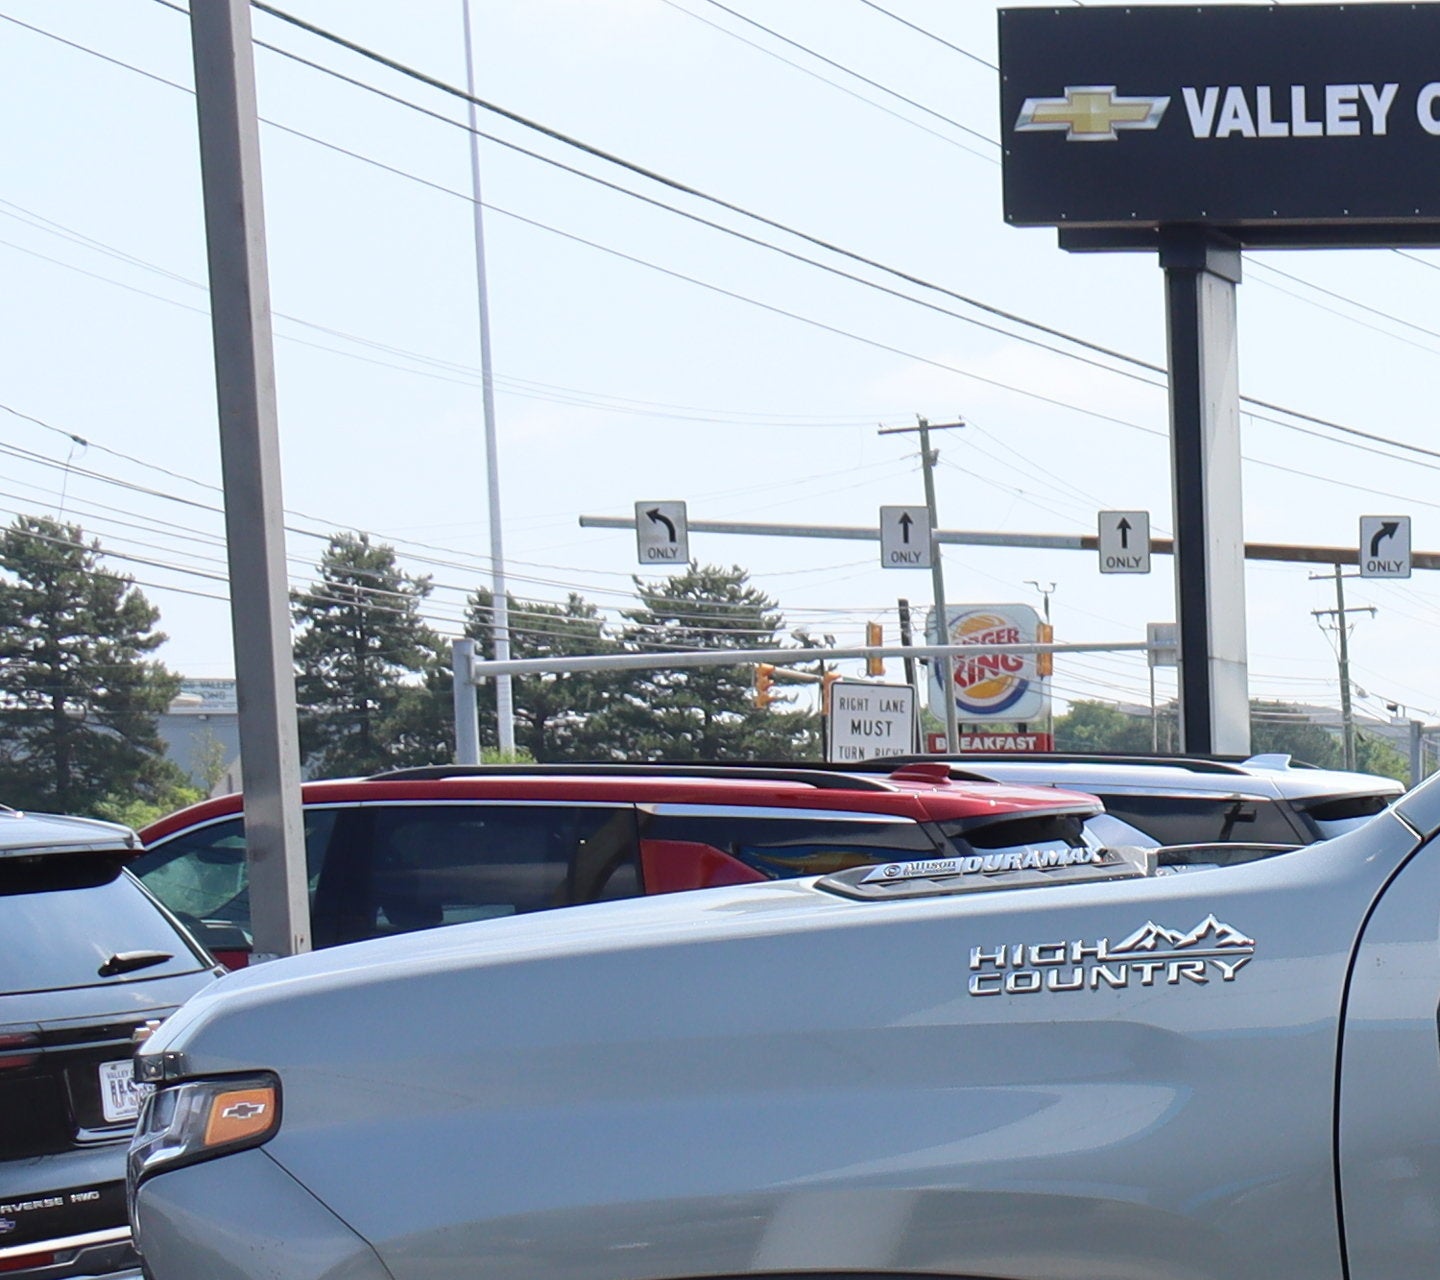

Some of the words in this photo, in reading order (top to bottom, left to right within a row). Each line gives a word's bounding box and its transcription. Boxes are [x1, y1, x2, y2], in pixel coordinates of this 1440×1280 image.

[1182, 83, 1400, 139] VALLEY
[647, 547, 679, 560] ONLY
[890, 551, 922, 564] ONLY
[1105, 556, 1142, 569] ONLY
[1366, 560, 1403, 573] ONLY
[839, 697, 869, 711] RIGHT
[880, 699, 905, 713] LANE
[851, 719, 893, 737] MUST
[935, 737, 1037, 750] BEAKFAST
[839, 745, 865, 760] TURN
[962, 847, 1103, 873] DURAMAX
[969, 938, 1108, 970] HIGH
[967, 957, 1253, 996] COUNTRY
